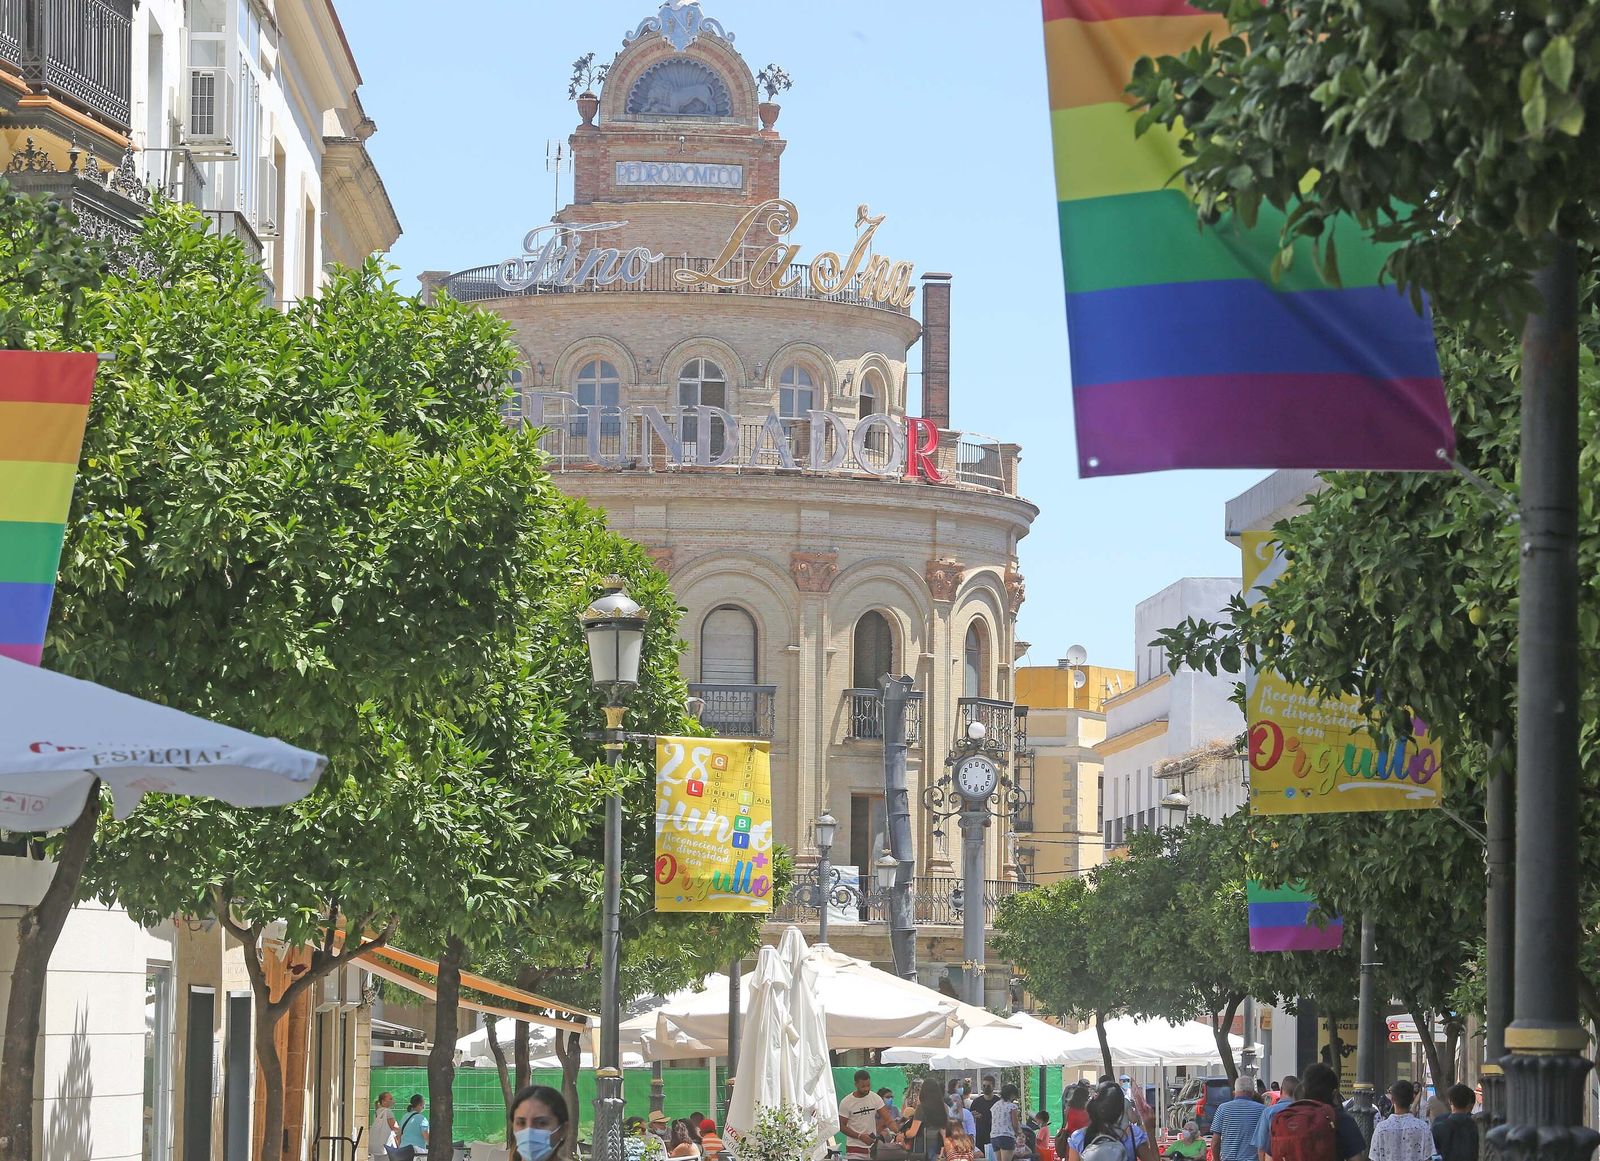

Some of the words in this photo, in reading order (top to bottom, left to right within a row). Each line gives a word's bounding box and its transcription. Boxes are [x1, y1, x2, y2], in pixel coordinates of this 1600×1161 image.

[496, 220, 663, 291] Fino
[673, 199, 803, 291] La
[524, 391, 947, 482] FUNDADOR
[1298, 727, 1326, 737] con
[93, 748, 231, 766] ESPECIAL
[656, 743, 711, 785] 28
[655, 853, 772, 901] Orgullo
